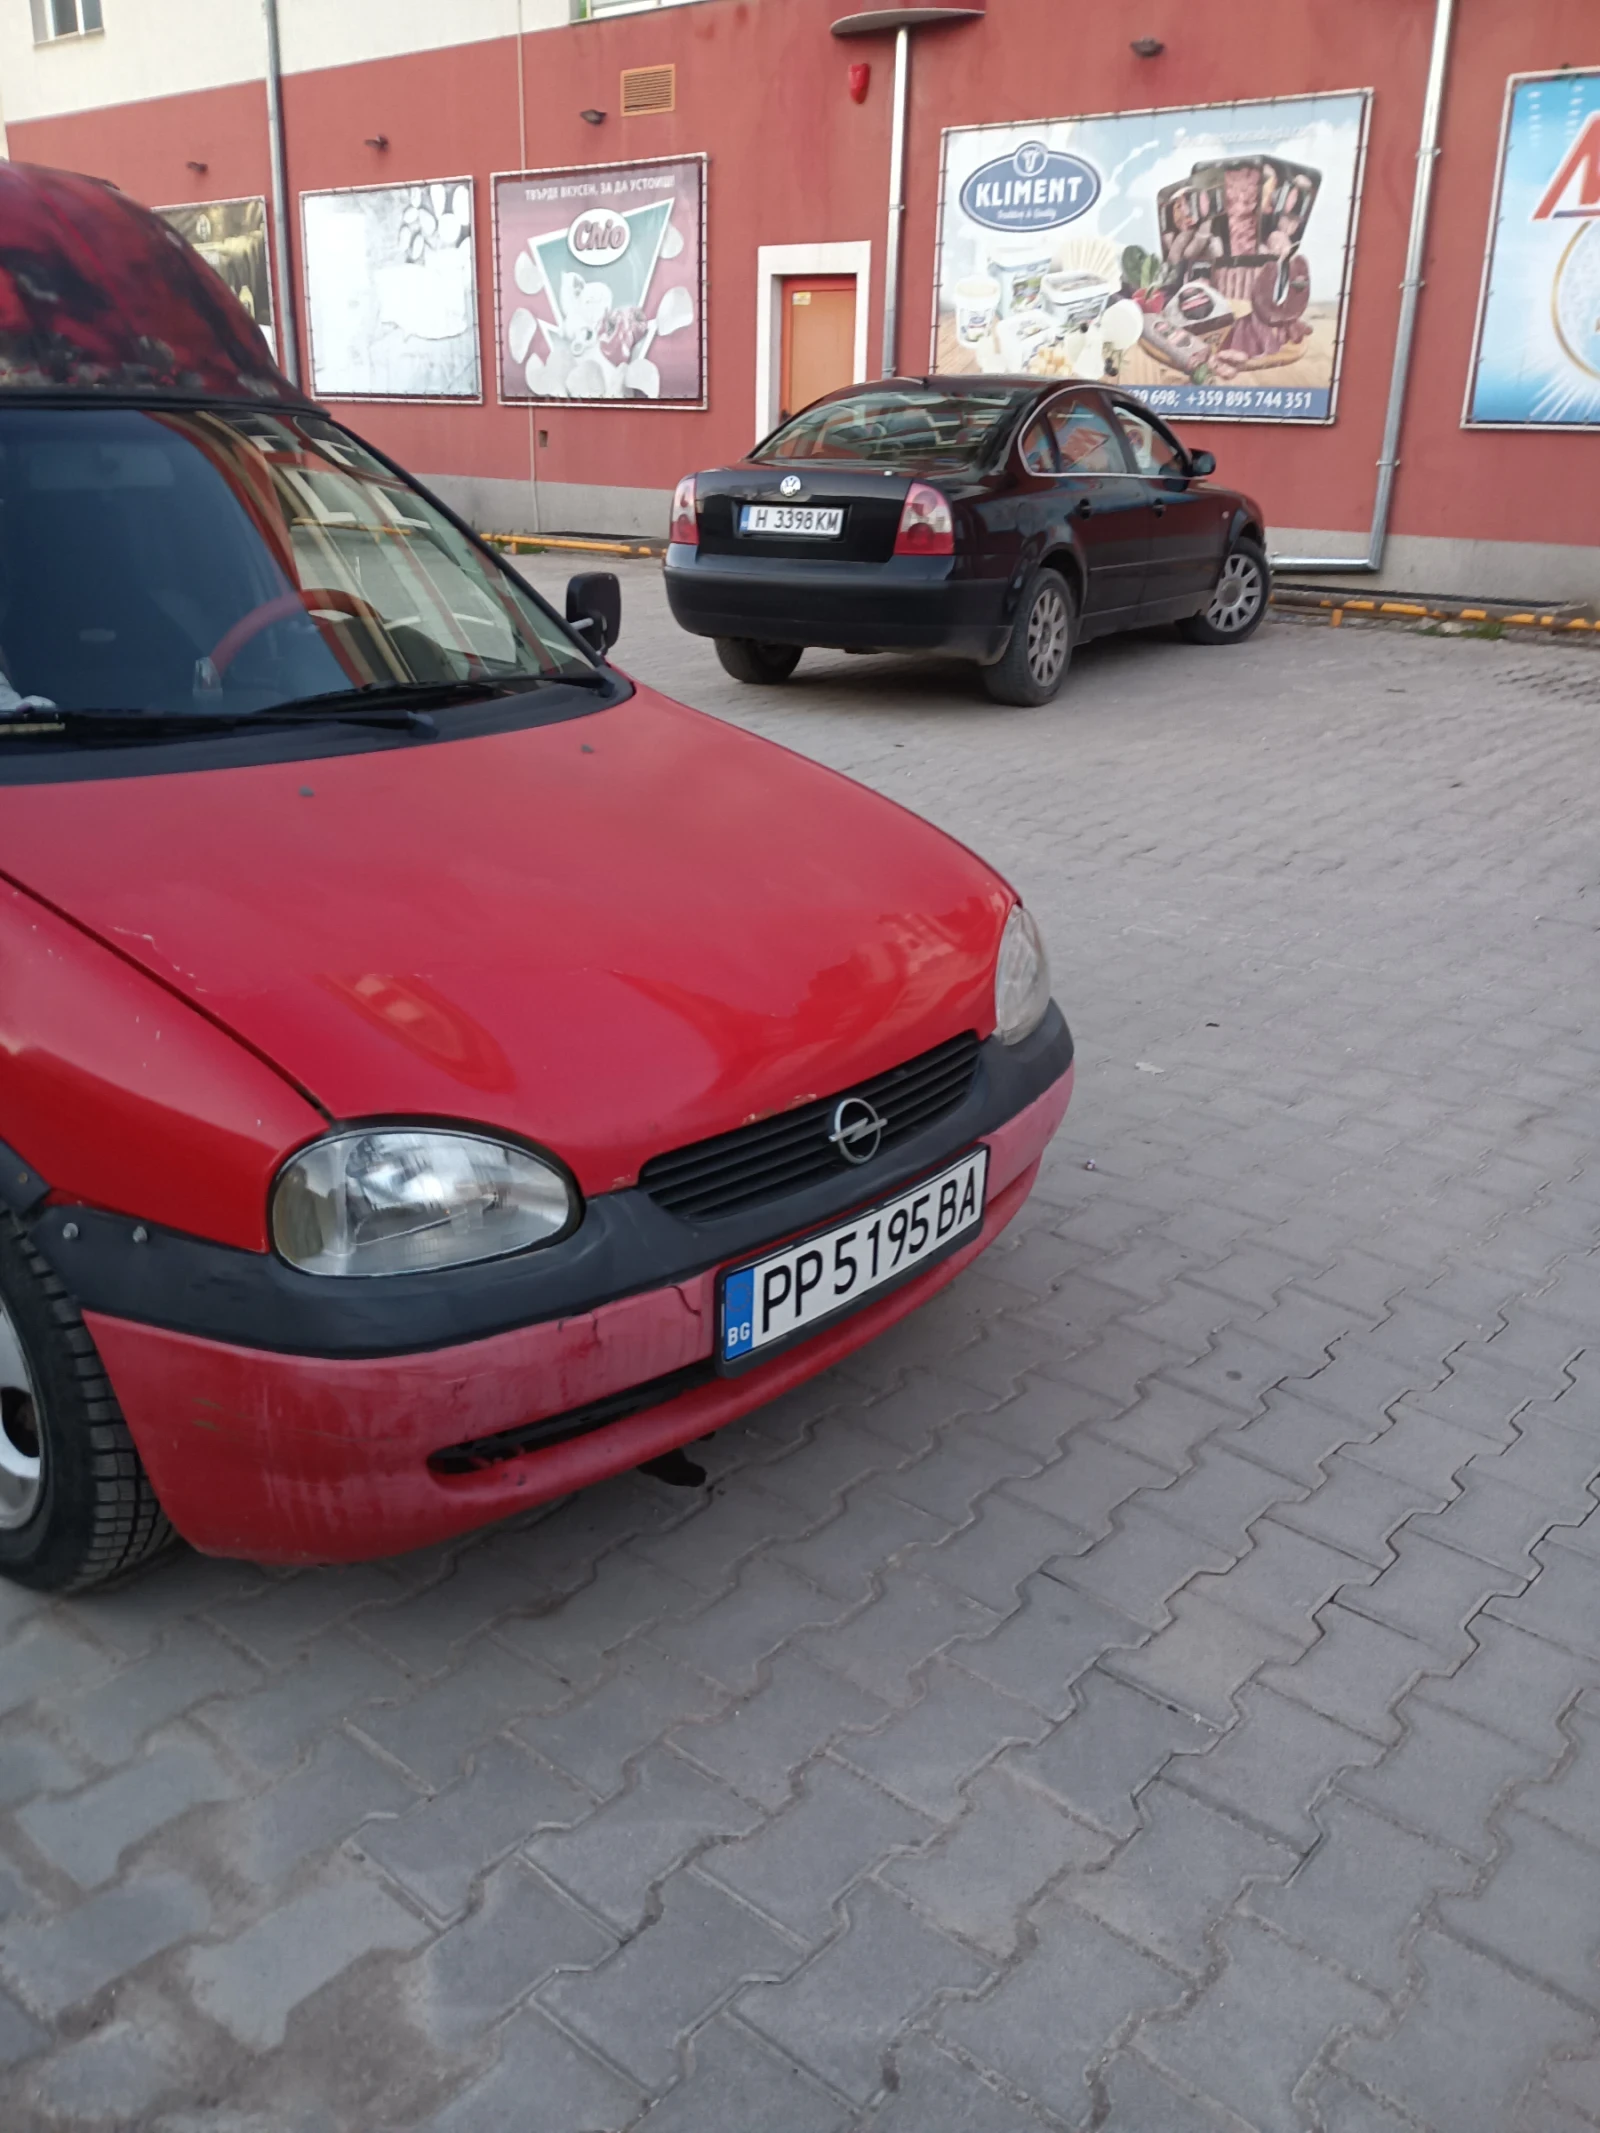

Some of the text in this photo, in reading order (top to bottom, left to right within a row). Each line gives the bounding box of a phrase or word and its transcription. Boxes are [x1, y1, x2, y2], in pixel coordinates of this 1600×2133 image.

[600, 181, 612, 195] ЗА
[614, 180, 628, 195] ДА
[975, 176, 1083, 208] KLIMENT
[573, 218, 626, 252] Chio
[1185, 390, 1222, 407] +359
[1225, 390, 1252, 407] 895
[1255, 391, 1281, 408] 744
[1284, 391, 1312, 409] 351
[755, 509, 769, 528] H
[727, 1322, 751, 1347] BG
